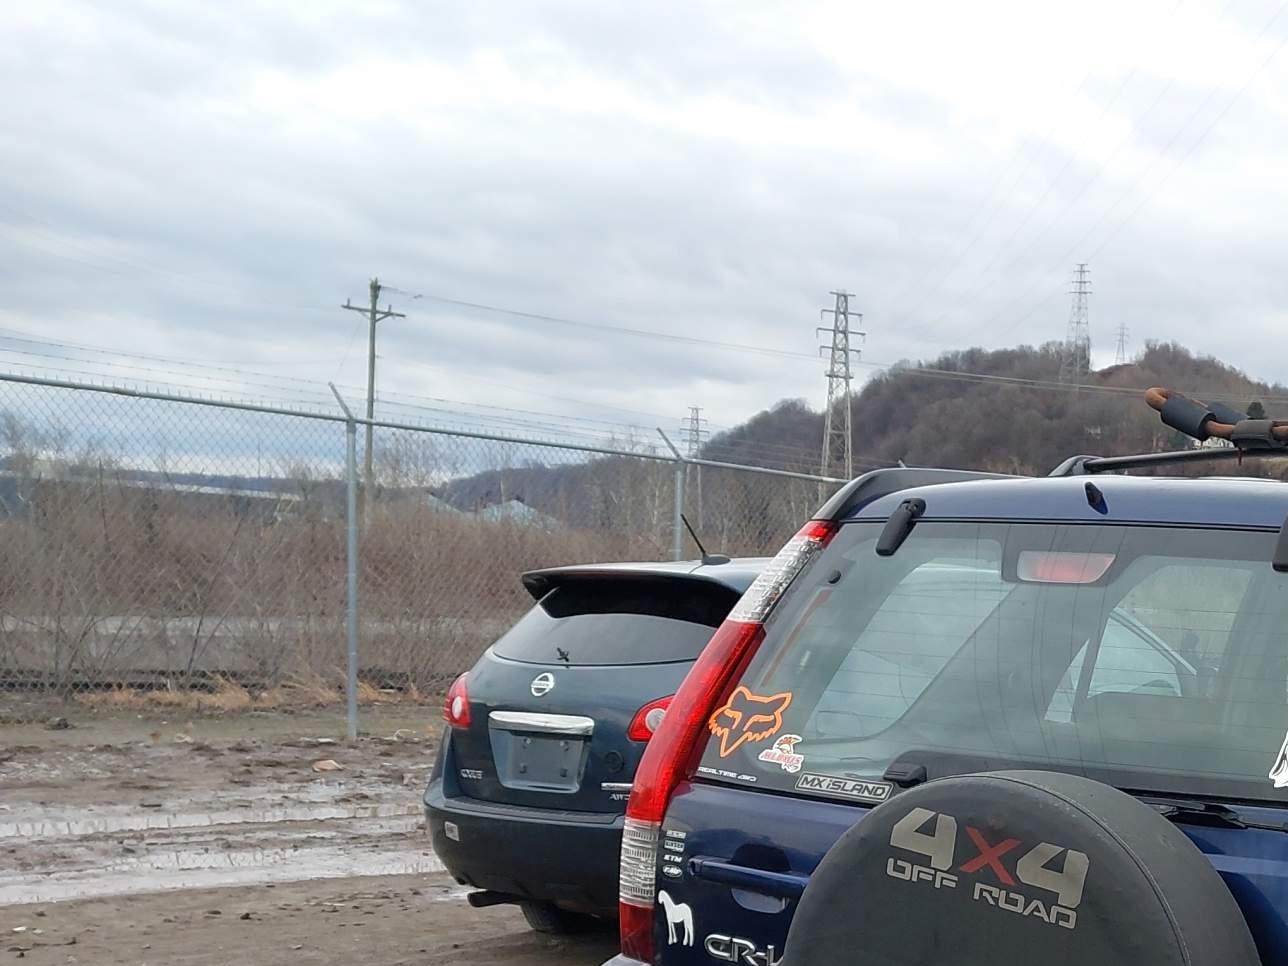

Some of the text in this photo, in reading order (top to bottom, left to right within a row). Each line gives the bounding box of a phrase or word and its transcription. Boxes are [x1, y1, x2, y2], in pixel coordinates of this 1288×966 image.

[800, 775, 828, 790] MX
[886, 857, 1078, 930] OFF ROAD
